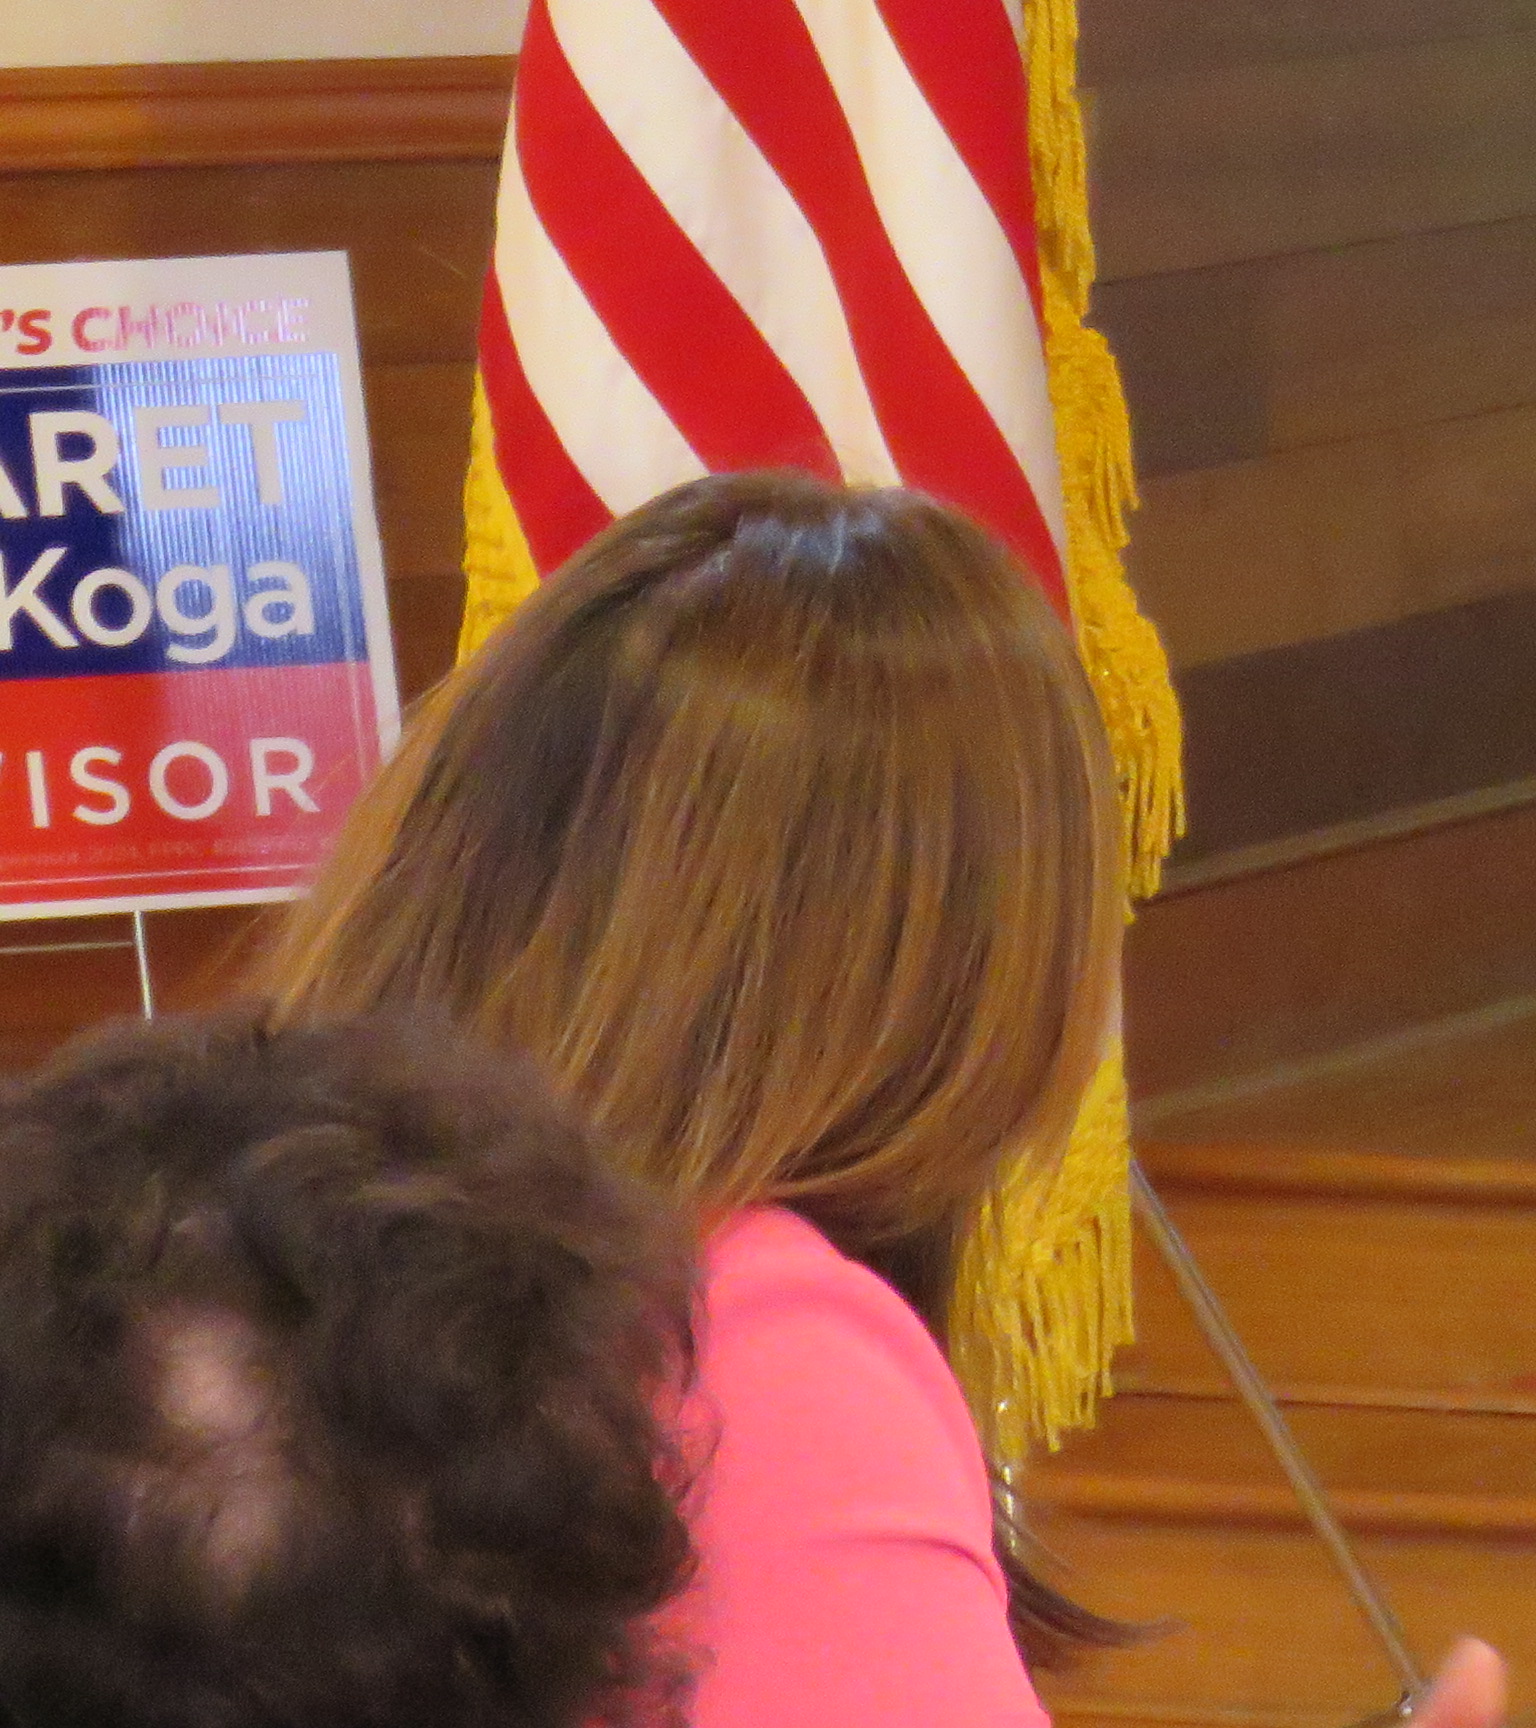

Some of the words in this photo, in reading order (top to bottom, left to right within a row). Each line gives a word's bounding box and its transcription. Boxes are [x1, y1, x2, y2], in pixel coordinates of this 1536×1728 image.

[71, 295, 309, 353] CHOICE
[0, 399, 308, 520] RET
[0, 546, 315, 664] Koga
[0, 736, 321, 828] ISOR
